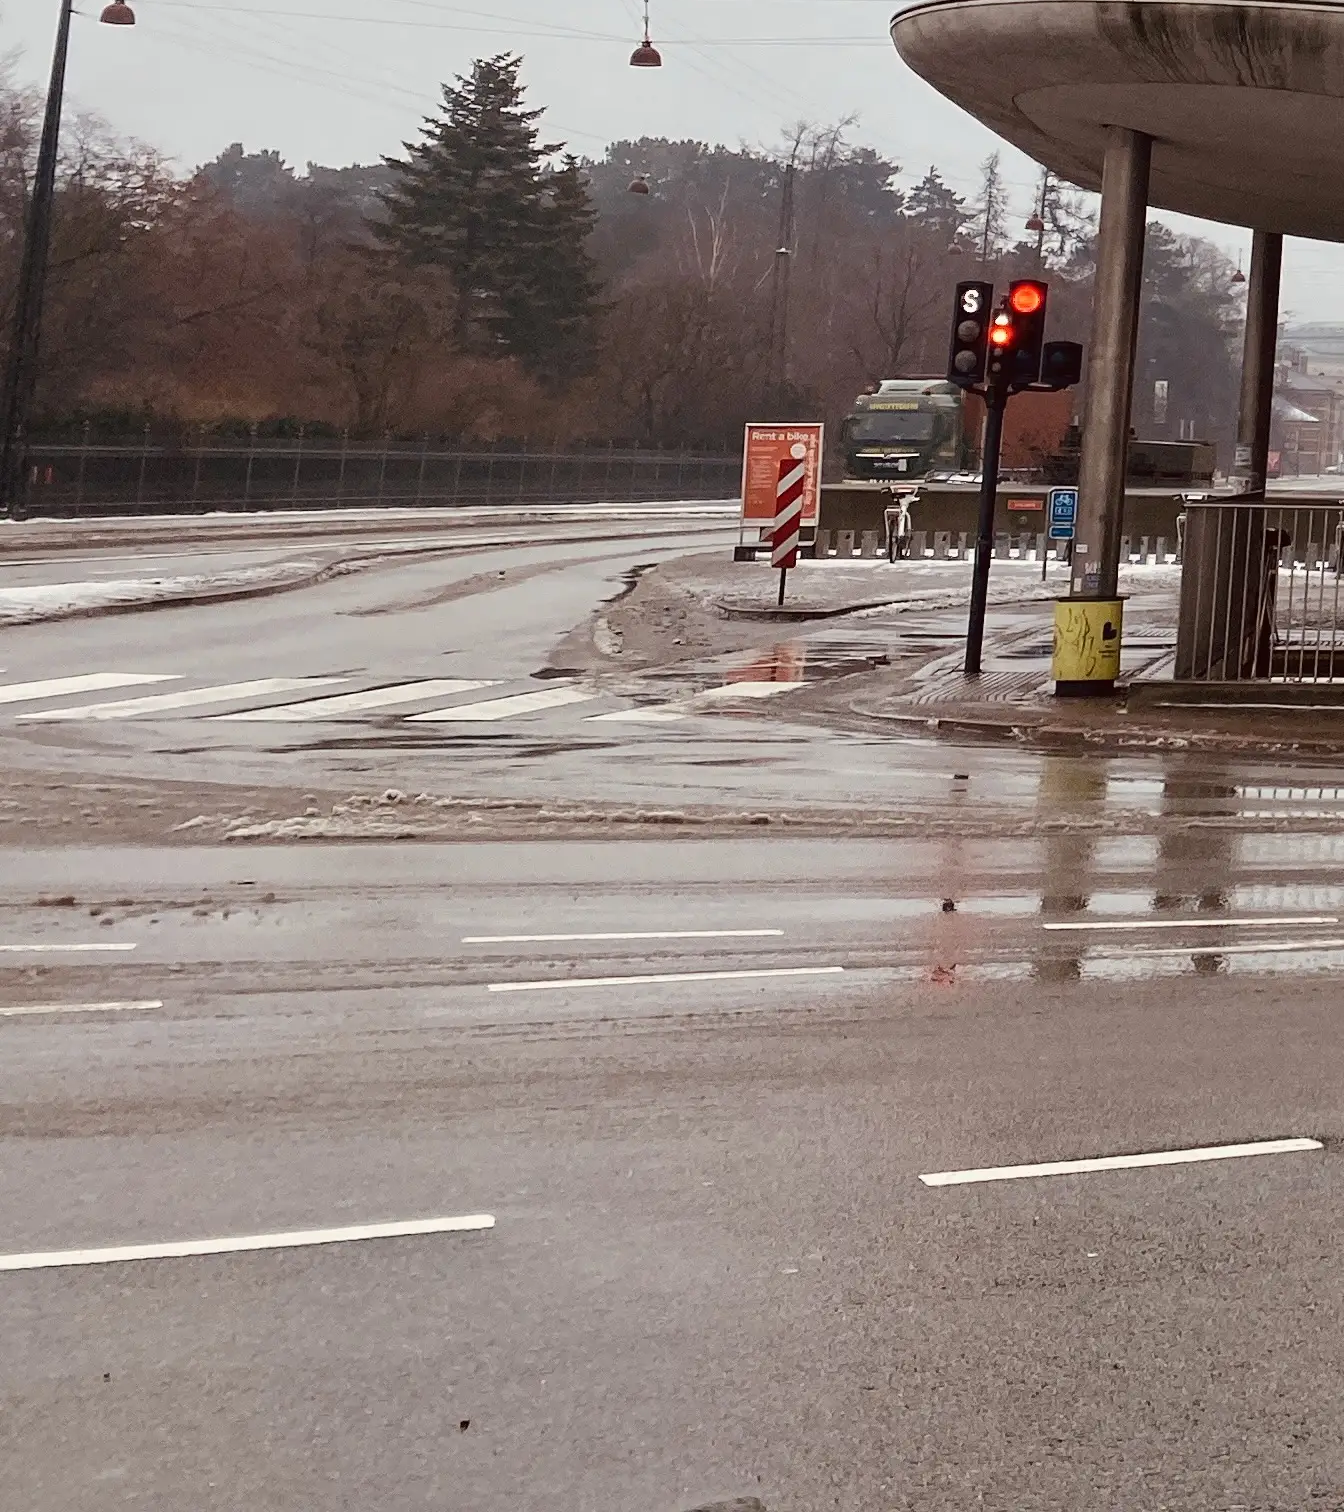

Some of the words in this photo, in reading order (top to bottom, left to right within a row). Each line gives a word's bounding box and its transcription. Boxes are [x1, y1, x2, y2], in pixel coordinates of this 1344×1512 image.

[962, 289, 980, 314] S
[752, 431, 777, 441] Rent
[778, 433, 785, 441] a
[786, 431, 809, 441] bike
